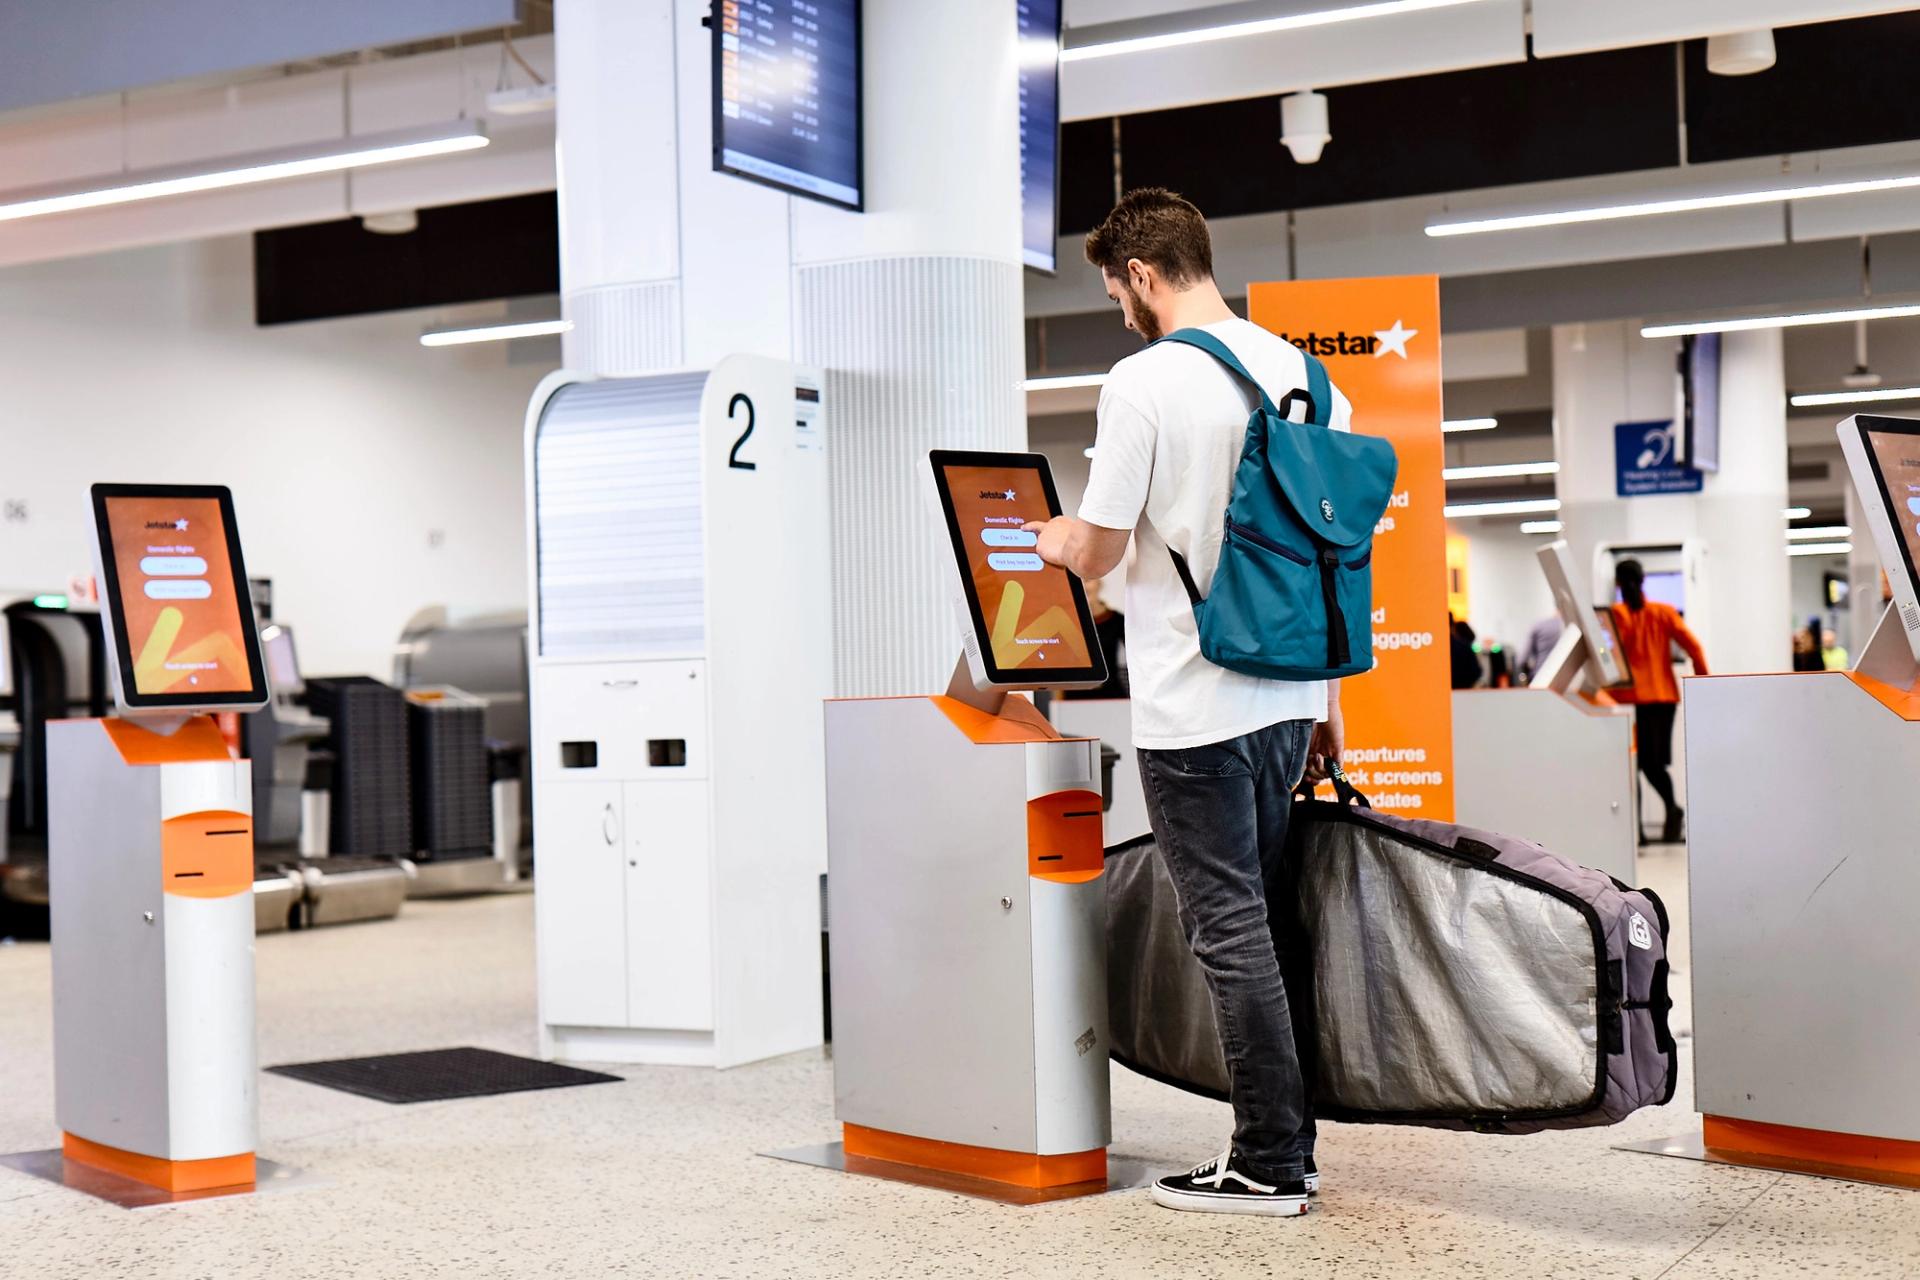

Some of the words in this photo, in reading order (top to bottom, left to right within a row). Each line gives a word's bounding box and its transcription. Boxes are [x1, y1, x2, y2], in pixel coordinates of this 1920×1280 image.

[1281, 331, 1378, 356] etstar
[728, 392, 756, 470] 2
[1387, 490, 1409, 507] nd
[1343, 747, 1426, 766] epartures
[1373, 771, 1443, 785] screens
